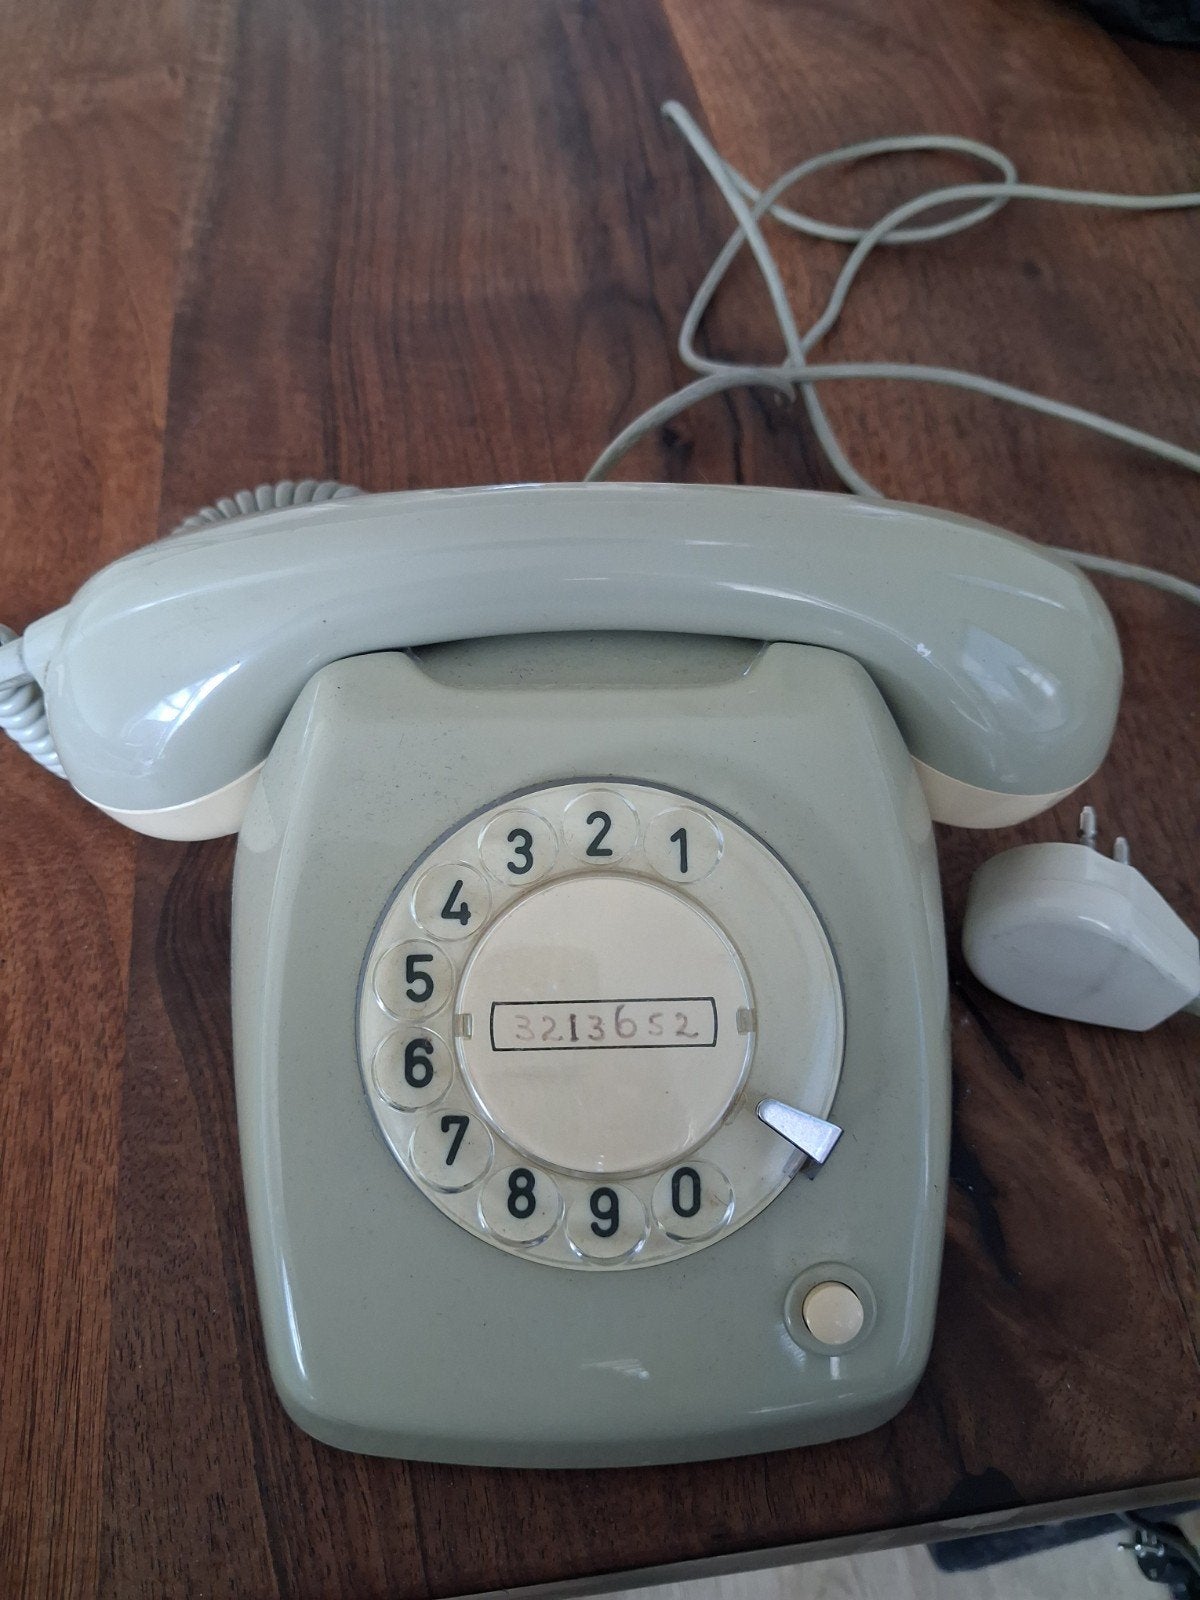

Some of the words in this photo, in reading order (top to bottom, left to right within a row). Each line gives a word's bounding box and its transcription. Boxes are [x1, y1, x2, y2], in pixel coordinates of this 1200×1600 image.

[506, 827, 534, 875] 3
[585, 810, 613, 857] 2
[669, 827, 689, 874] 1
[440, 879, 472, 926] 4
[405, 953, 435, 1004] 5
[514, 1004, 699, 1042] 3213652
[403, 1036, 437, 1089] 6
[440, 1114, 471, 1166] 7
[507, 1168, 537, 1220] 8
[589, 1187, 620, 1239] 9
[671, 1166, 702, 1219] 0
